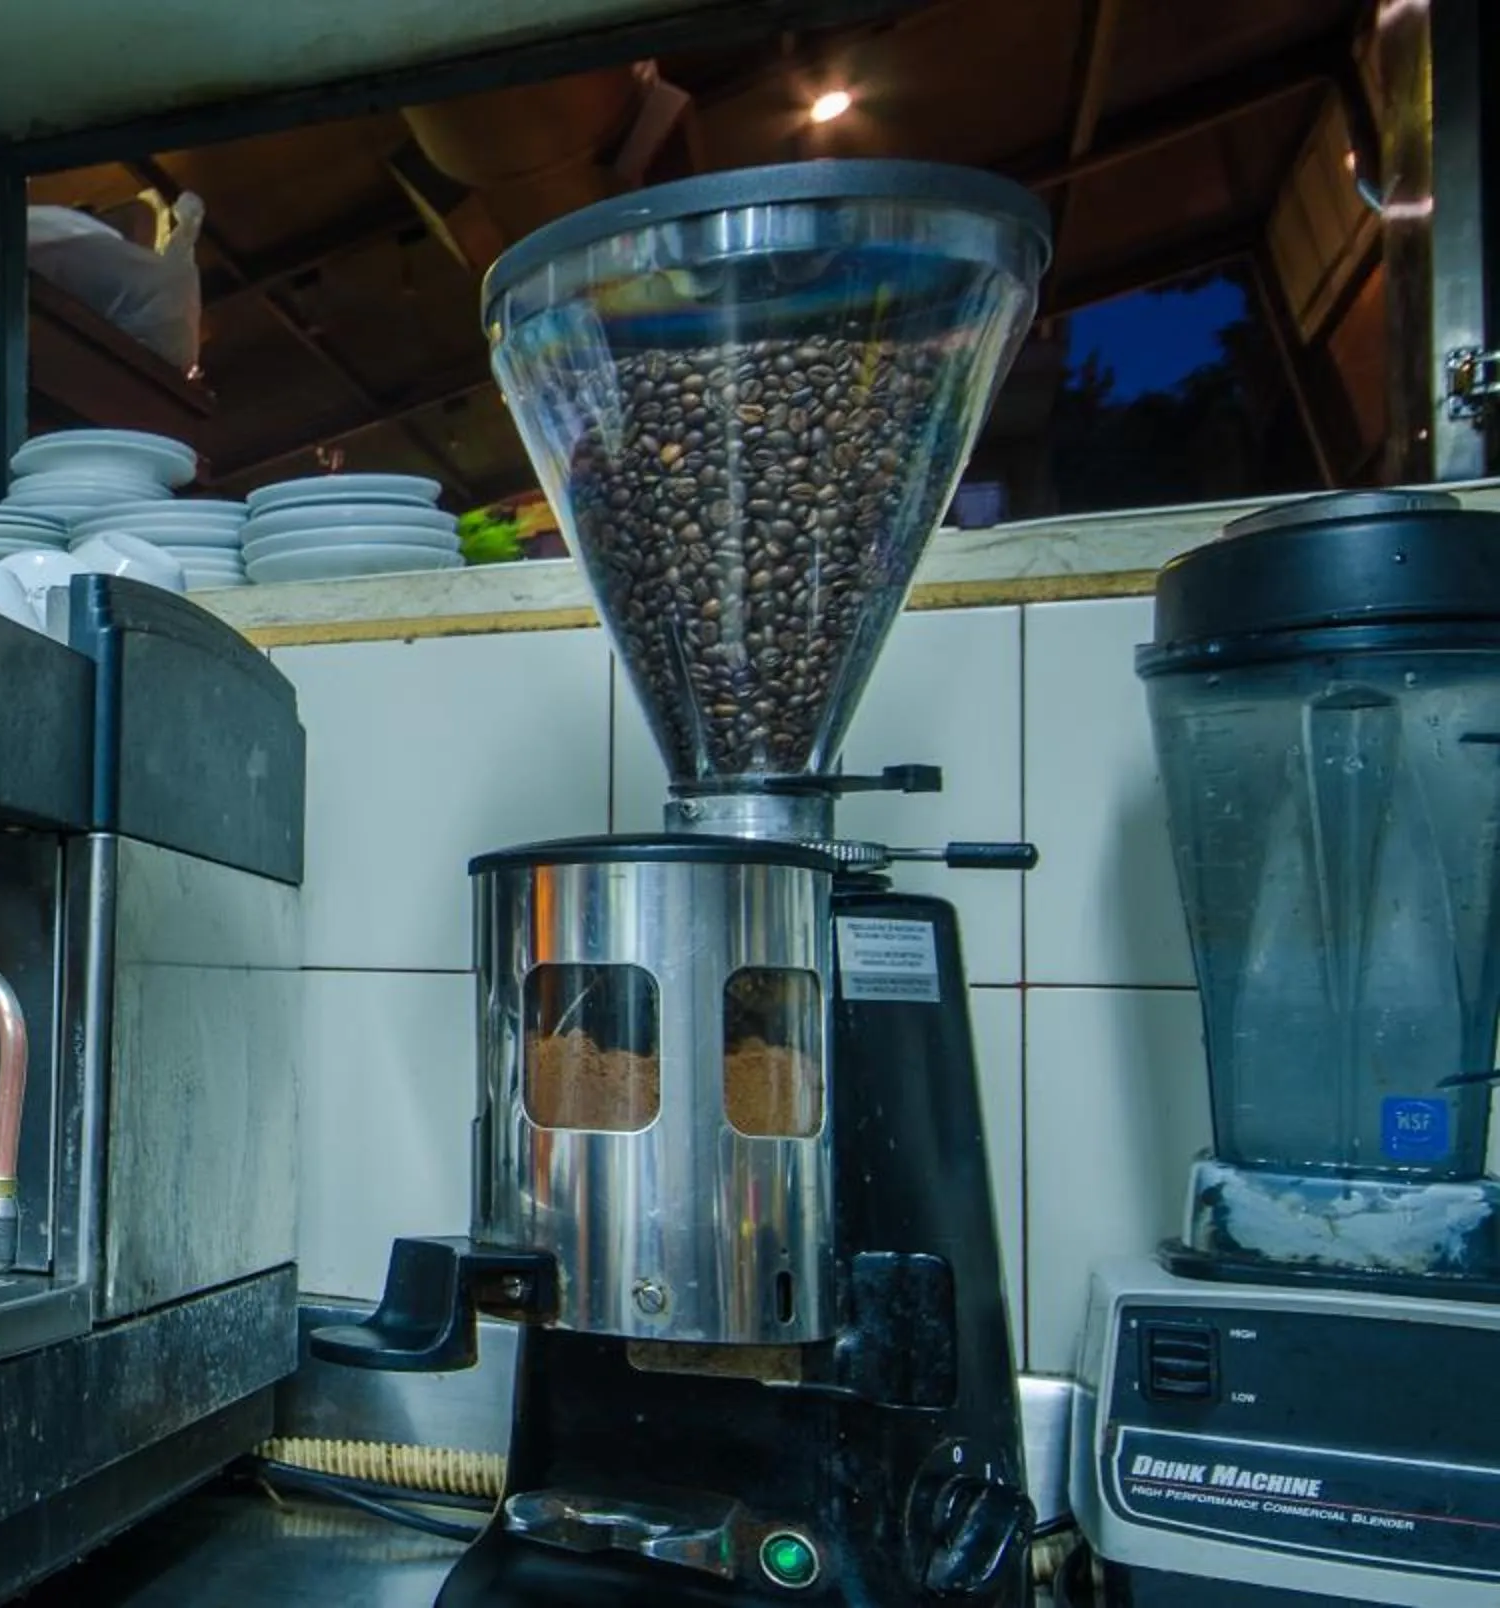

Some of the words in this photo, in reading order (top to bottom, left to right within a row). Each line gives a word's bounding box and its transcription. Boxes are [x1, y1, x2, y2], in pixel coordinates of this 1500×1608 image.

[1229, 1328, 1257, 1340] HIGH
[1230, 1391, 1256, 1404] LOW
[1131, 1454, 1208, 1483] DRINK
[1210, 1463, 1324, 1498] MACHINE
[1131, 1484, 1163, 1498] HIGH
[1164, 1488, 1260, 1512] PERFORMANCE
[1262, 1501, 1348, 1523] COMMERCIAL
[1351, 1513, 1416, 1531] BLENDER
